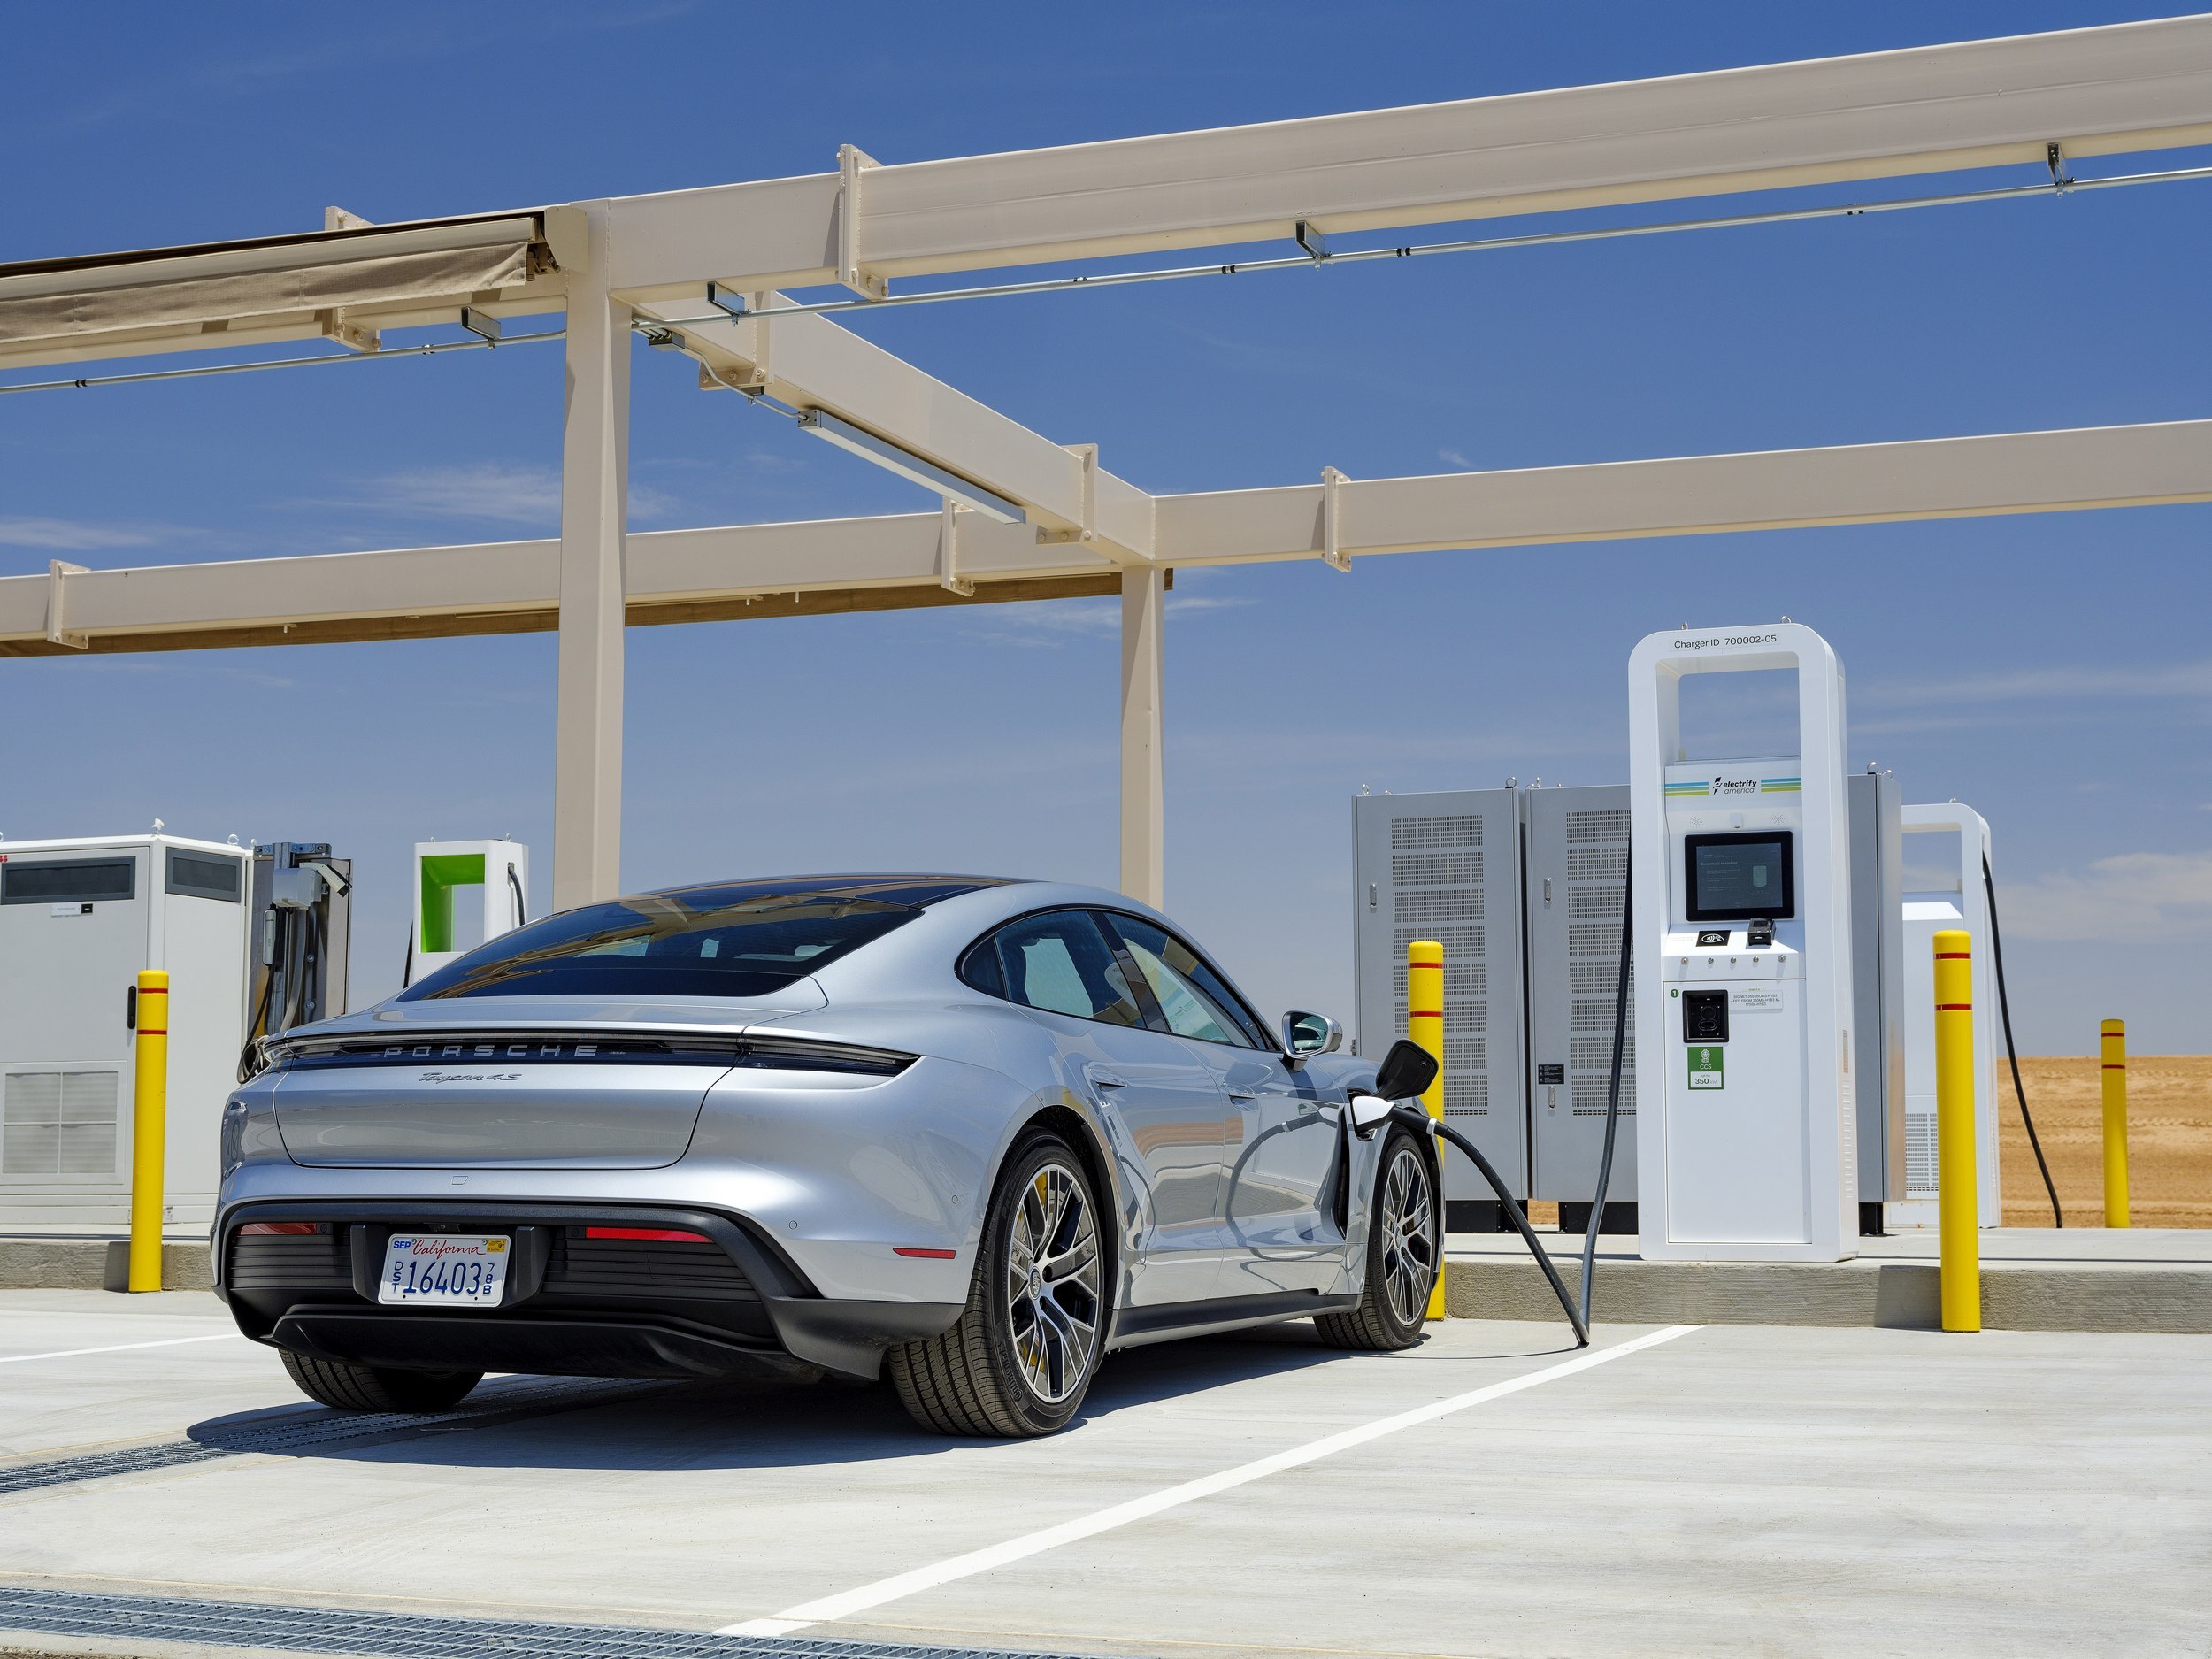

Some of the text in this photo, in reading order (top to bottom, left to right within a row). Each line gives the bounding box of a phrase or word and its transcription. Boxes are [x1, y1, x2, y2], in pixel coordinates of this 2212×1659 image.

[1674, 634, 1778, 649] Charger ID 700002-05
[383, 1044, 598, 1058] PORSCHE
[419, 1071, 523, 1085] Taycan 4S
[393, 1240, 411, 1249] SEP
[413, 1239, 487, 1259] California
[403, 1260, 482, 1295] 16403
